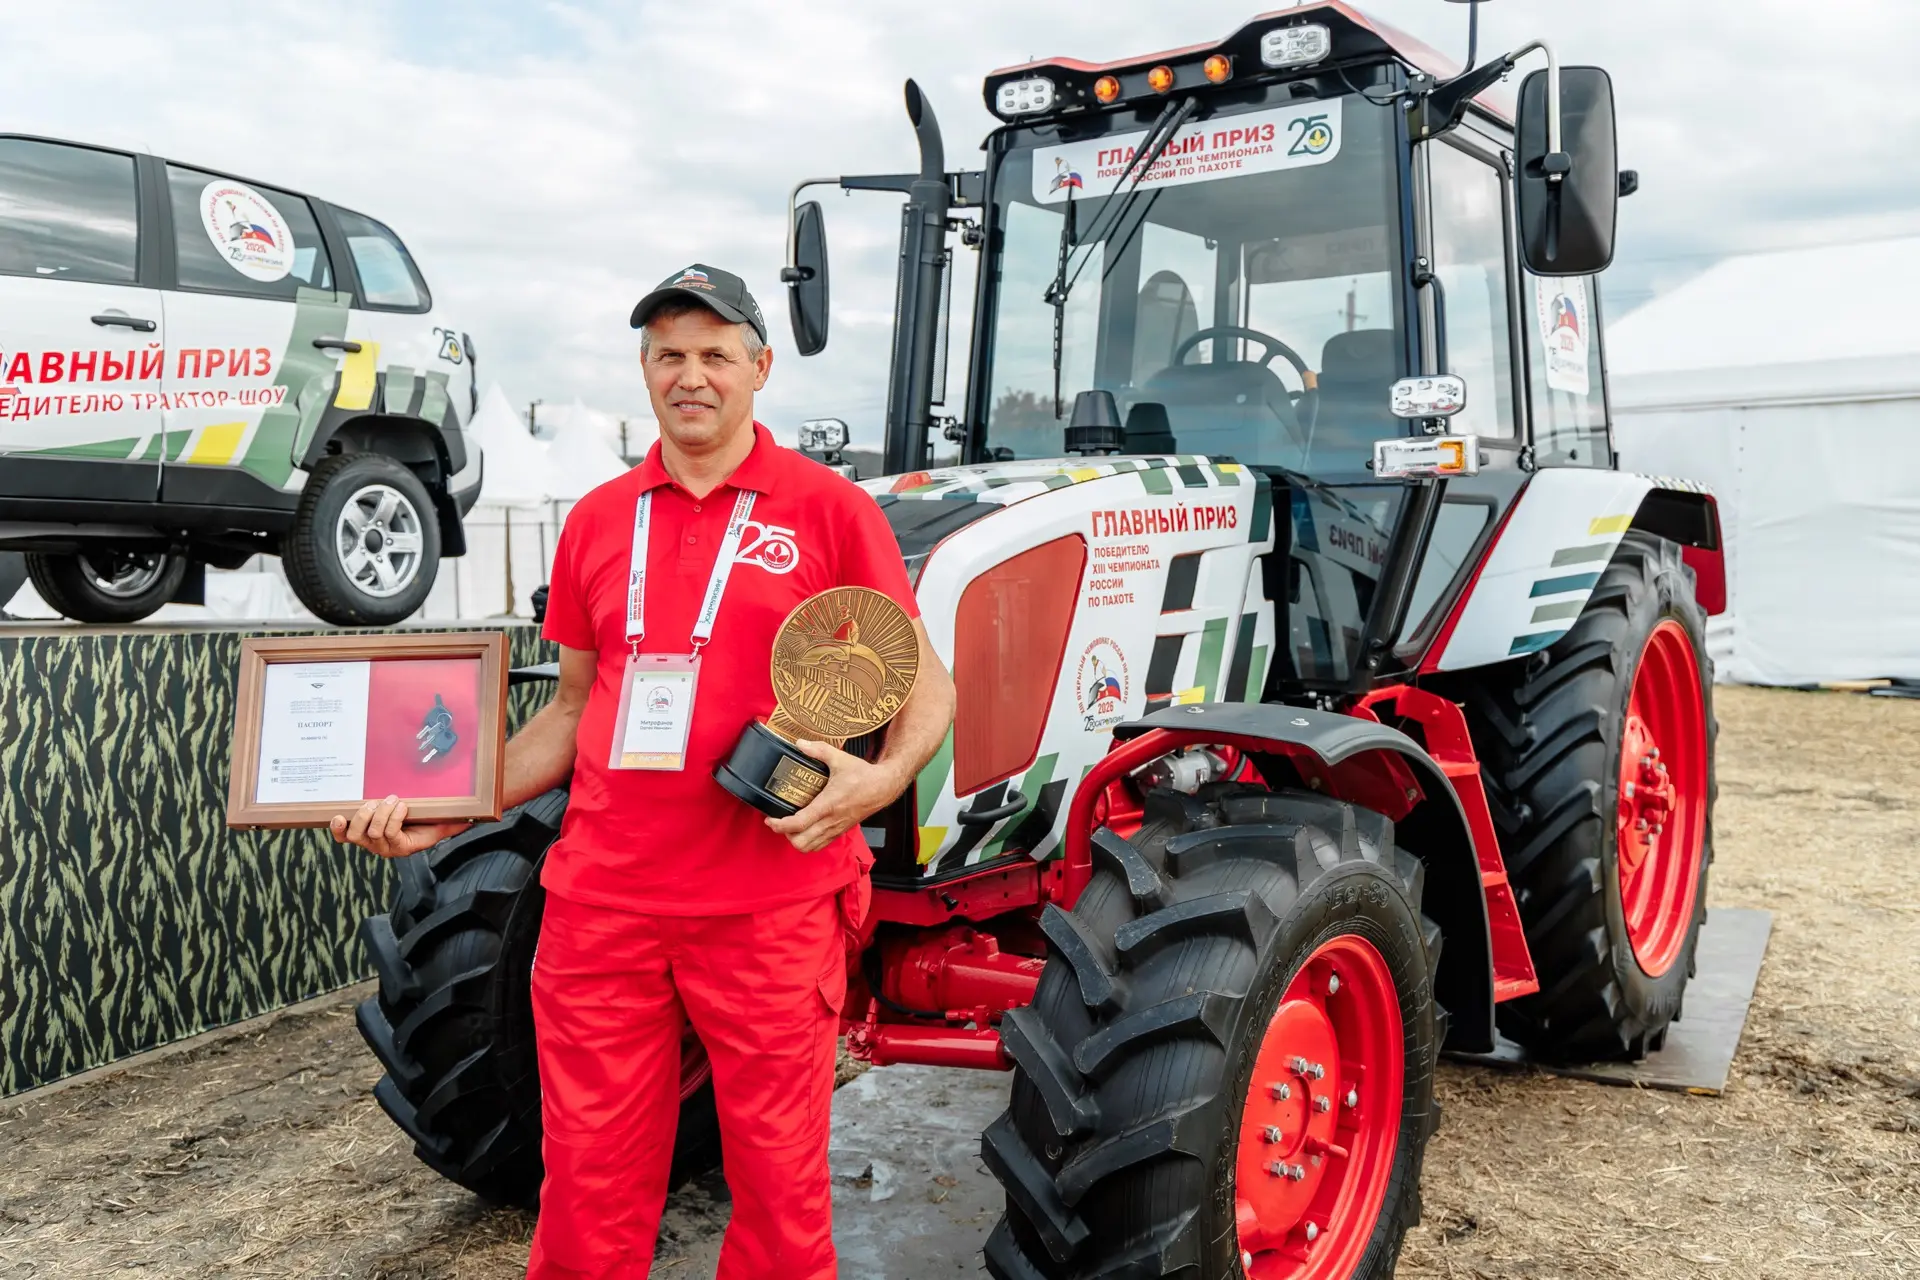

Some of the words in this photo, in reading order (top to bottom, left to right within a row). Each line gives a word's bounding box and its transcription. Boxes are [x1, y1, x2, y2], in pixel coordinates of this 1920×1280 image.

[1097, 132, 1205, 167] ГЛАЫЙ
[1212, 123, 1275, 150] ПРИЗ
[1287, 114, 1333, 157] 25
[1175, 156, 1193, 166] XIII
[1196, 144, 1274, 164] ЧЕМПИОНАТА
[1179, 166, 1195, 178] ПО
[1198, 159, 1243, 175] ПАХОТЕ
[0, 342, 164, 384] АВНЫЙ
[177, 348, 272, 379] ПРИЗ
[131, 387, 286, 411] ТРАКТОР-ШОУ
[1091, 502, 1189, 538] ГЛАВНЫЙ
[1193, 504, 1238, 532] ПРИЗ
[733, 520, 800, 575] 25
[1094, 544, 1150, 559] ПОБЕДИТЕЛЮ
[1092, 562, 1106, 575] XIII
[1108, 559, 1160, 573] ЧЕМПИОНАТА
[1089, 578, 1124, 591] РОССИИ
[1088, 596, 1101, 607] ПО
[1102, 592, 1135, 606] ПАХОТЕ
[789, 677, 831, 714] XIII
[1098, 701, 1114, 714] 2026
[795, 768, 824, 787] МЕСТО
